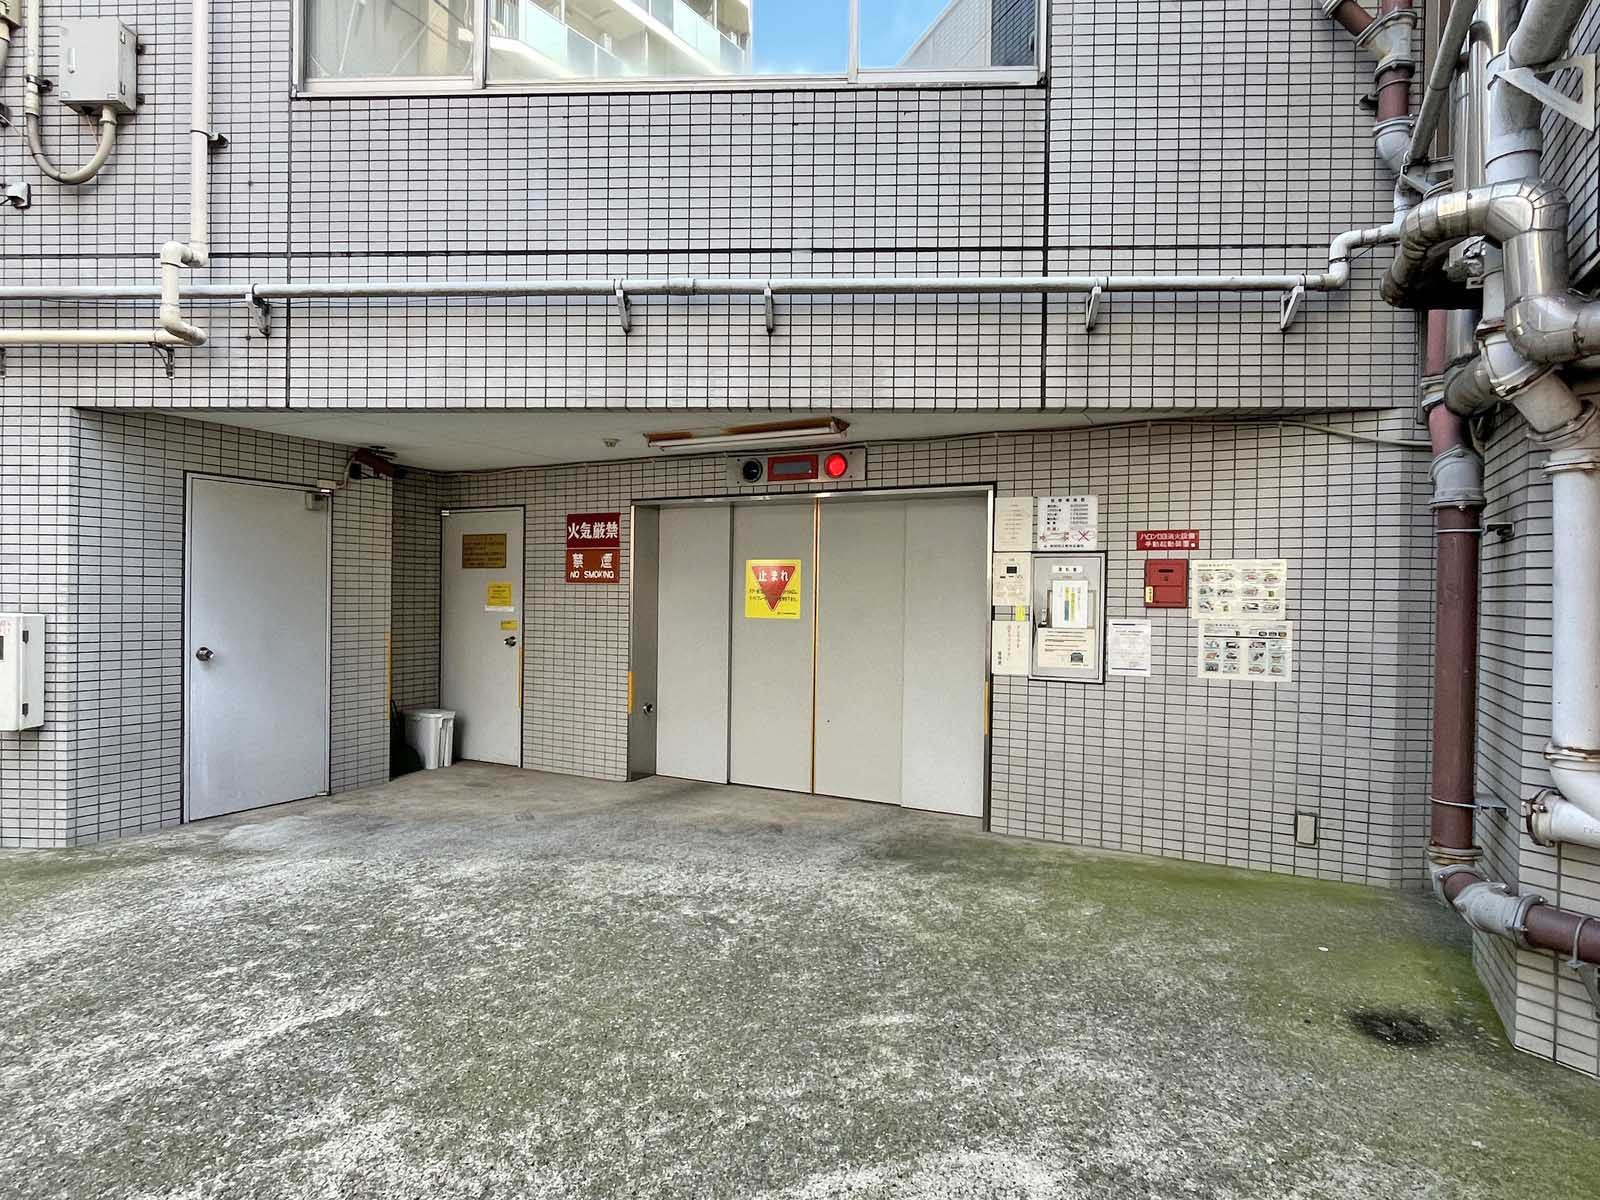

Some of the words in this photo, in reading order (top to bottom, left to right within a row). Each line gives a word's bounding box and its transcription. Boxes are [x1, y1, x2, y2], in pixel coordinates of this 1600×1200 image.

[567, 521, 618, 540] 火気厳禁
[569, 570, 580, 579] NO
[583, 569, 615, 579] SMOKING
[758, 569, 789, 582] 止まれ
